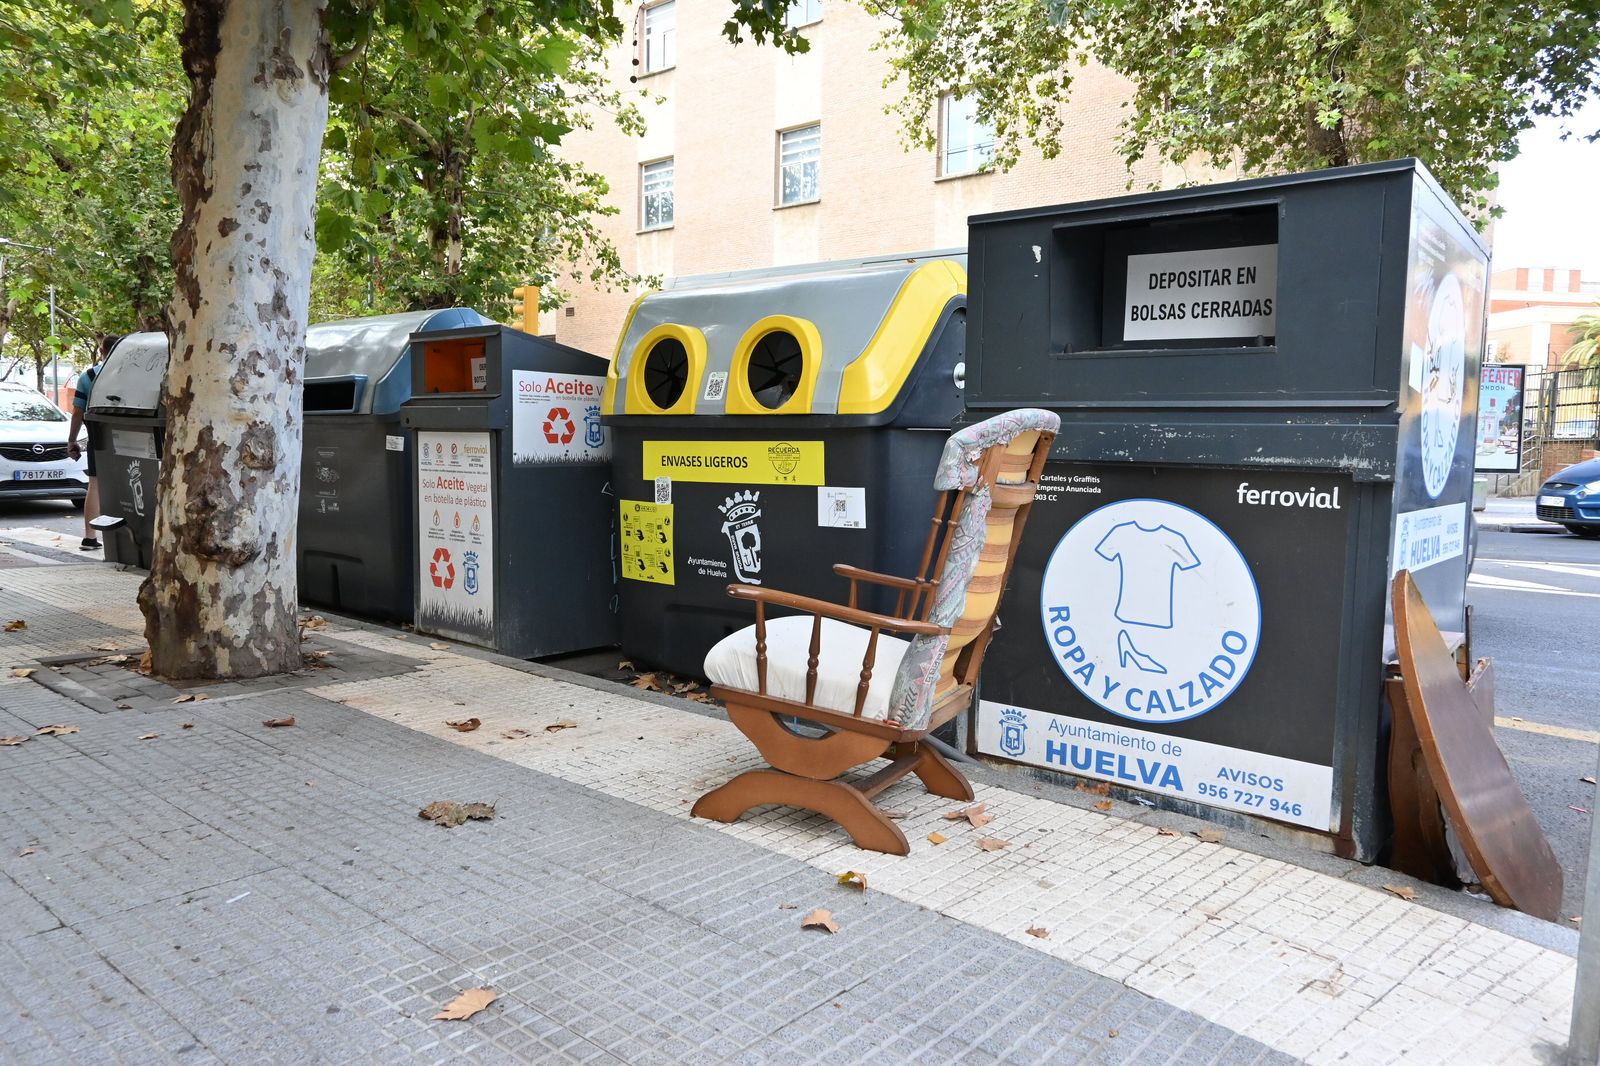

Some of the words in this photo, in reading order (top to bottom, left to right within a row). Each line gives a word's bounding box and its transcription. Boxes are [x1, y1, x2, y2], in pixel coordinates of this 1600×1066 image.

[1149, 269, 1232, 290] DEPOSITAR
[1237, 266, 1257, 285] EN
[1131, 303, 1186, 321] BOLSAS
[1191, 298, 1273, 319] CERRADAS
[519, 380, 542, 393] Solo
[544, 378, 593, 395] Aceite
[662, 456, 702, 467] ENVASES
[705, 456, 748, 468] LIGEROS
[22, 471, 44, 479] 7817
[48, 470, 64, 479] KRP
[422, 479, 435, 489] Solo
[436, 476, 465, 491] Aceite
[466, 482, 488, 494] Vegetal
[1037, 484, 1064, 492] Empresa
[1237, 483, 1341, 509] ferrovial
[434, 494, 453, 504] botella
[455, 496, 462, 505] de
[464, 496, 486, 507] plástico
[688, 556, 727, 568] Ayuntamiento
[1410, 535, 1440, 567] HUELVA
[698, 567, 706, 575] de
[707, 569, 727, 578] Huelva
[1049, 606, 1096, 686] ROPA
[1102, 676, 1121, 700] Y
[1125, 630, 1248, 714] CALZADO
[1048, 719, 1156, 752] Ayuntamiento
[1162, 740, 1182, 757] de
[1046, 739, 1184, 792] HUELVA
[1217, 767, 1284, 792] AVISOS
[1198, 782, 1228, 800] 956
[1233, 791, 1264, 807] 727
[1269, 798, 1302, 817] 946
